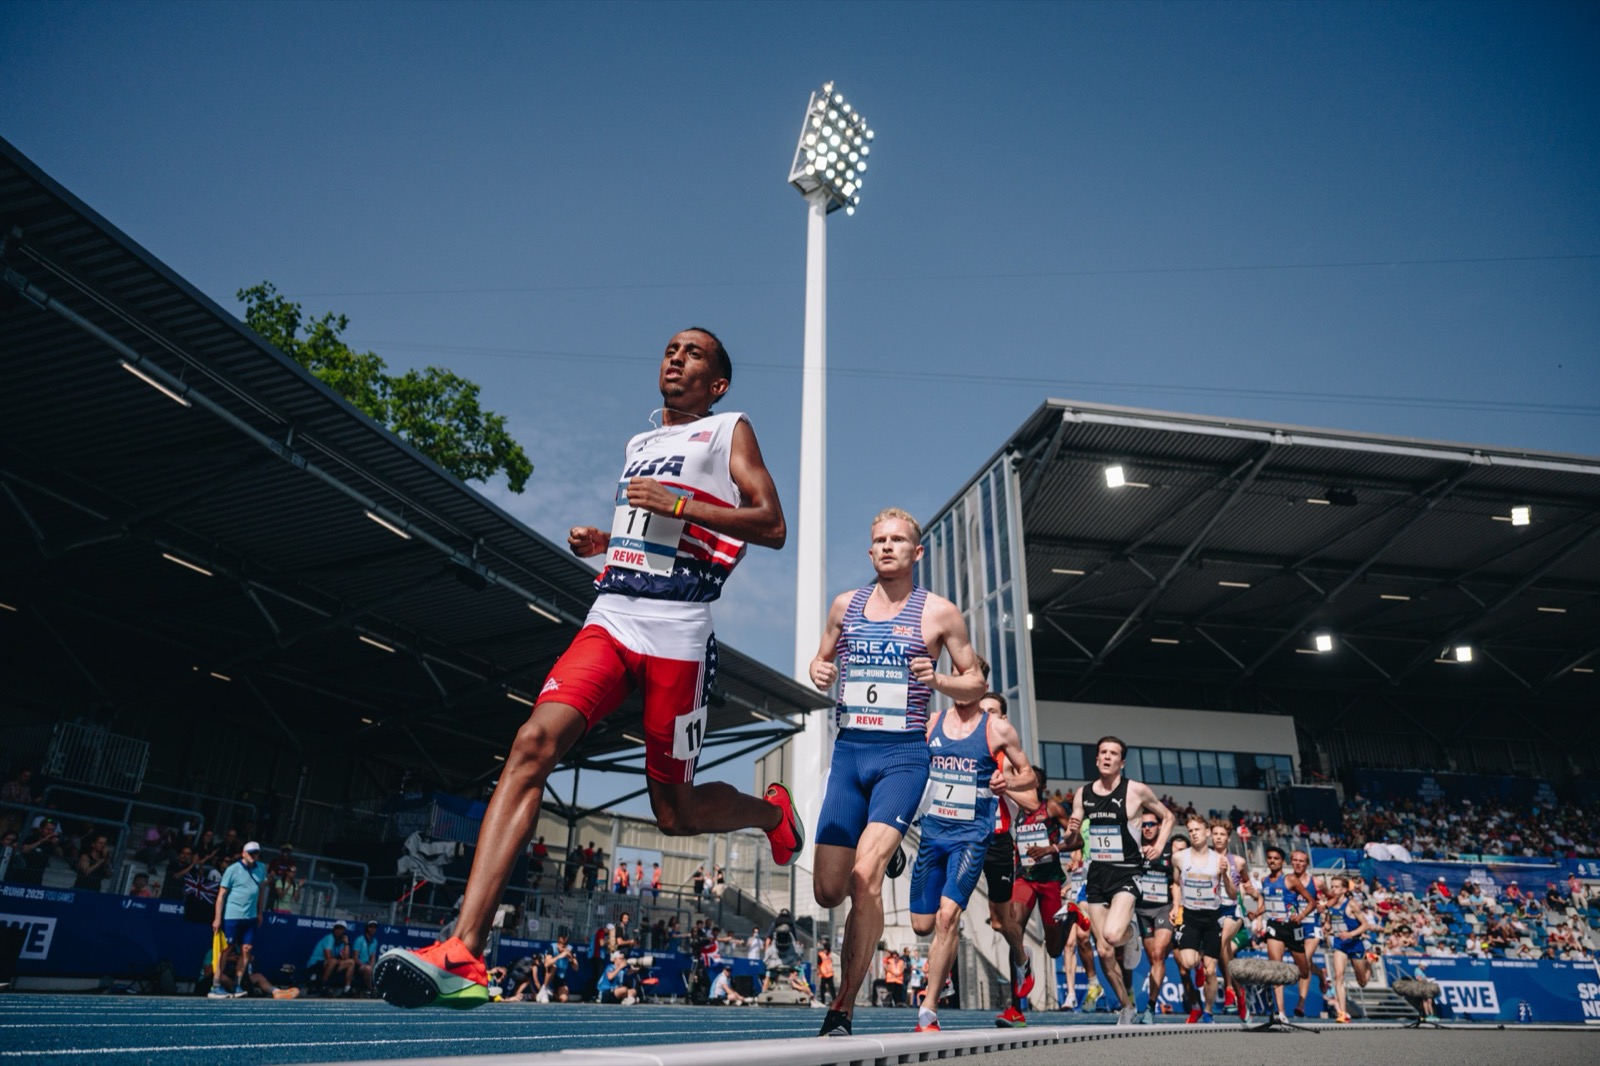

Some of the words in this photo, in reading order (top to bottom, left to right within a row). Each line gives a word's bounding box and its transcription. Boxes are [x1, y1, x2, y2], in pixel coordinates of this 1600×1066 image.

[624, 455, 686, 479] USA
[626, 509, 652, 537] 11
[612, 549, 646, 566] REWE
[847, 640, 910, 655] GREAT
[885, 670, 903, 679] 2025
[866, 683, 878, 705] 6
[856, 715, 884, 726] REWE
[685, 718, 701, 752] 11
[932, 755, 978, 773] FRANCE
[945, 784, 954, 799] 7
[938, 807, 958, 817] REWE
[1017, 822, 1048, 834] KENYA
[1097, 836, 1111, 848] 16
[0, 884, 25, 898] -RUHR
[25, 888, 46, 900] 2025
[1151, 884, 1156, 892] 4
[1196, 889, 1202, 897] 5
[1577, 982, 1600, 999] SP
